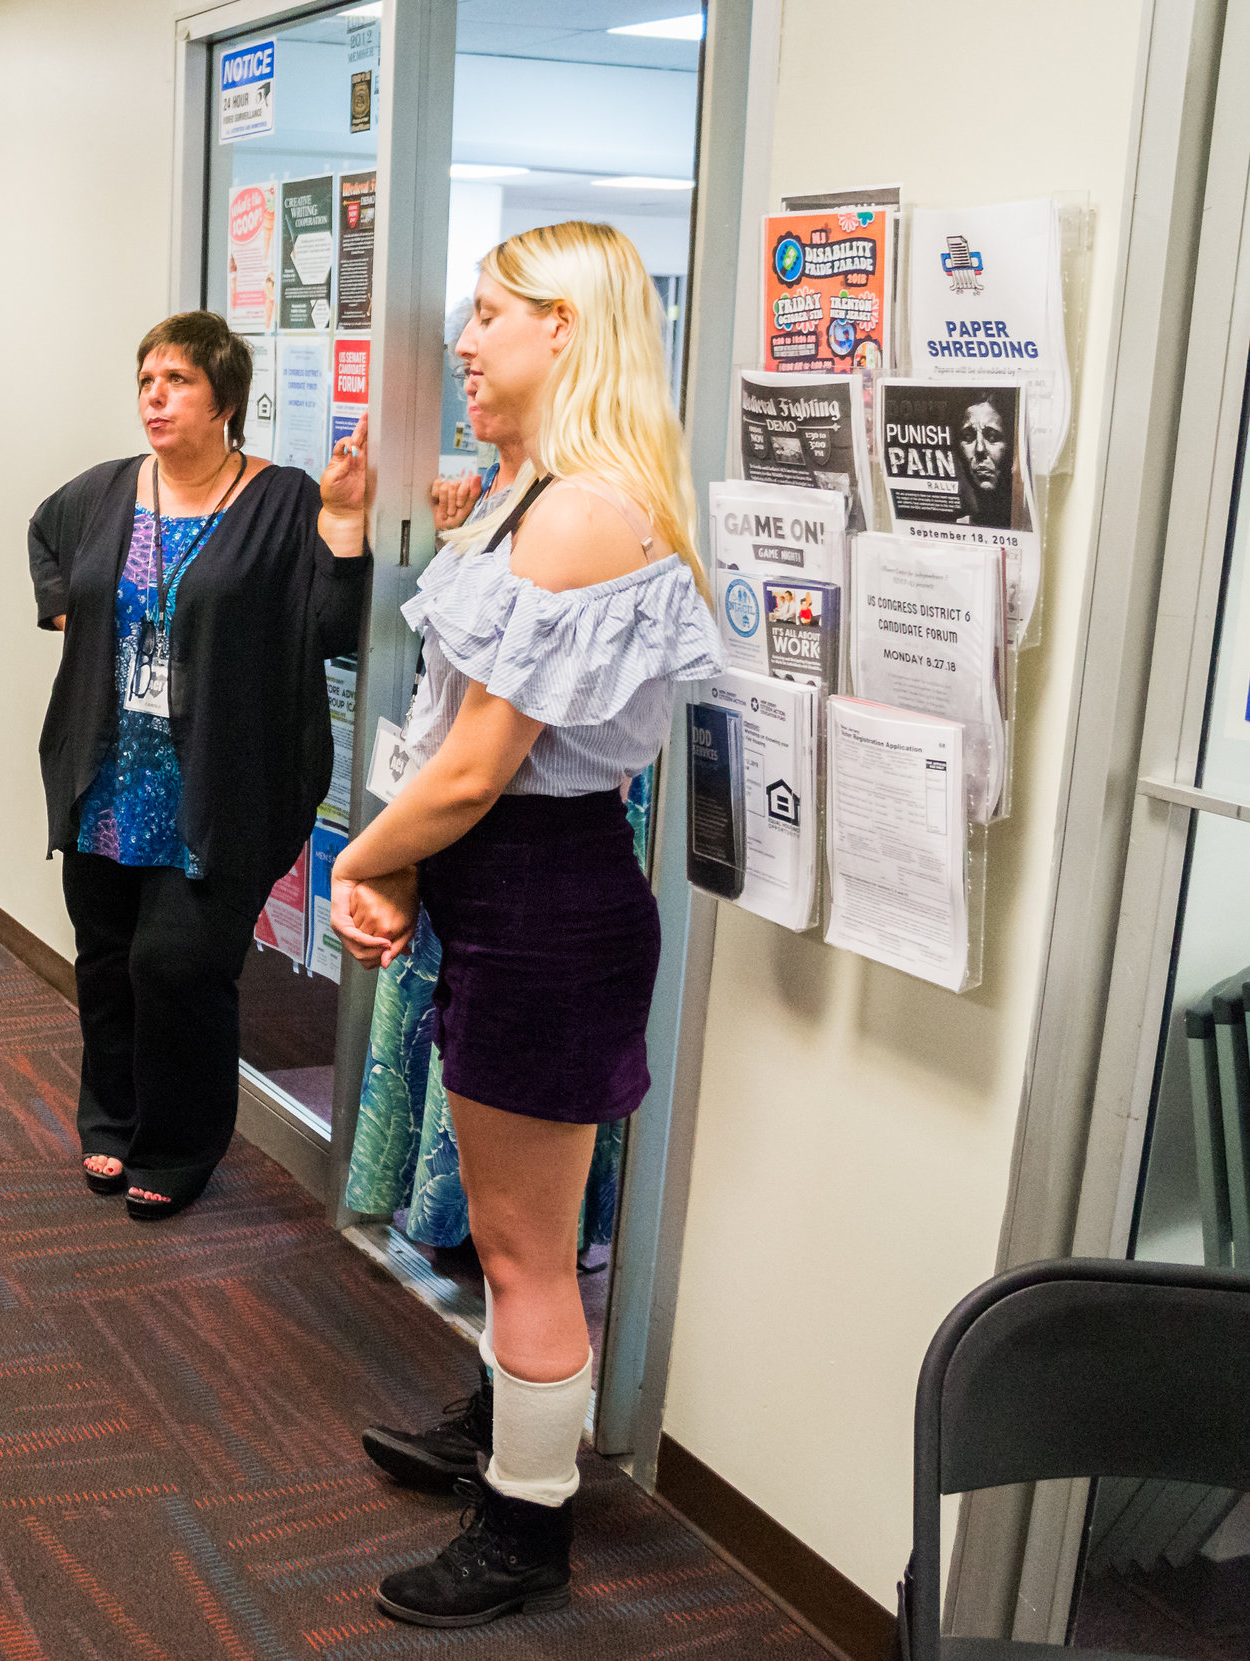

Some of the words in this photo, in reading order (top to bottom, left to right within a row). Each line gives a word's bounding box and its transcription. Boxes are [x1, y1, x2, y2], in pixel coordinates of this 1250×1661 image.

[351, 30, 372, 48] 2012
[223, 48, 273, 85] NOTICE
[223, 98, 231, 111] 24
[233, 93, 249, 109] HOUR
[284, 195, 312, 208] CREATIVE
[291, 205, 318, 218] WRITING
[804, 241, 873, 264] DISABILITY
[804, 262, 833, 276] PRIDE
[833, 257, 874, 274] PARADE
[778, 293, 822, 315] FRIDAY
[830, 297, 872, 311] TRENTON
[945, 321, 1010, 338] PAPER
[339, 352, 346, 363] US
[346, 352, 367, 364] SENATE
[927, 340, 1039, 358] SHREDDING
[338, 363, 366, 376] CANDIDATE
[337, 376, 366, 393] FORUM
[777, 397, 841, 421] Fighting
[766, 419, 797, 433] DEMO
[886, 423, 951, 446] PUNISH
[888, 447, 956, 477] PAIN
[926, 481, 956, 491] RALLY
[724, 512, 786, 540] GAME
[790, 518, 825, 544] ON!
[910, 526, 967, 541] September
[971, 533, 988, 544] 18,
[992, 535, 1019, 547] 2018
[758, 548, 779, 560] GAME
[867, 594, 876, 607] US
[877, 597, 918, 615] CONGRESS
[919, 604, 961, 622] DISTRICT
[964, 611, 971, 623] 6
[772, 627, 785, 637] IT'S
[785, 629, 797, 638] ALL
[797, 631, 821, 642] ABOUT
[878, 618, 923, 638] CANDIDATE
[925, 627, 958, 643] FORUM
[883, 648, 924, 666] MONDAY
[926, 657, 957, 673] 8.27.18
[853, 733, 884, 747] Registration
[886, 742, 923, 753] Application
